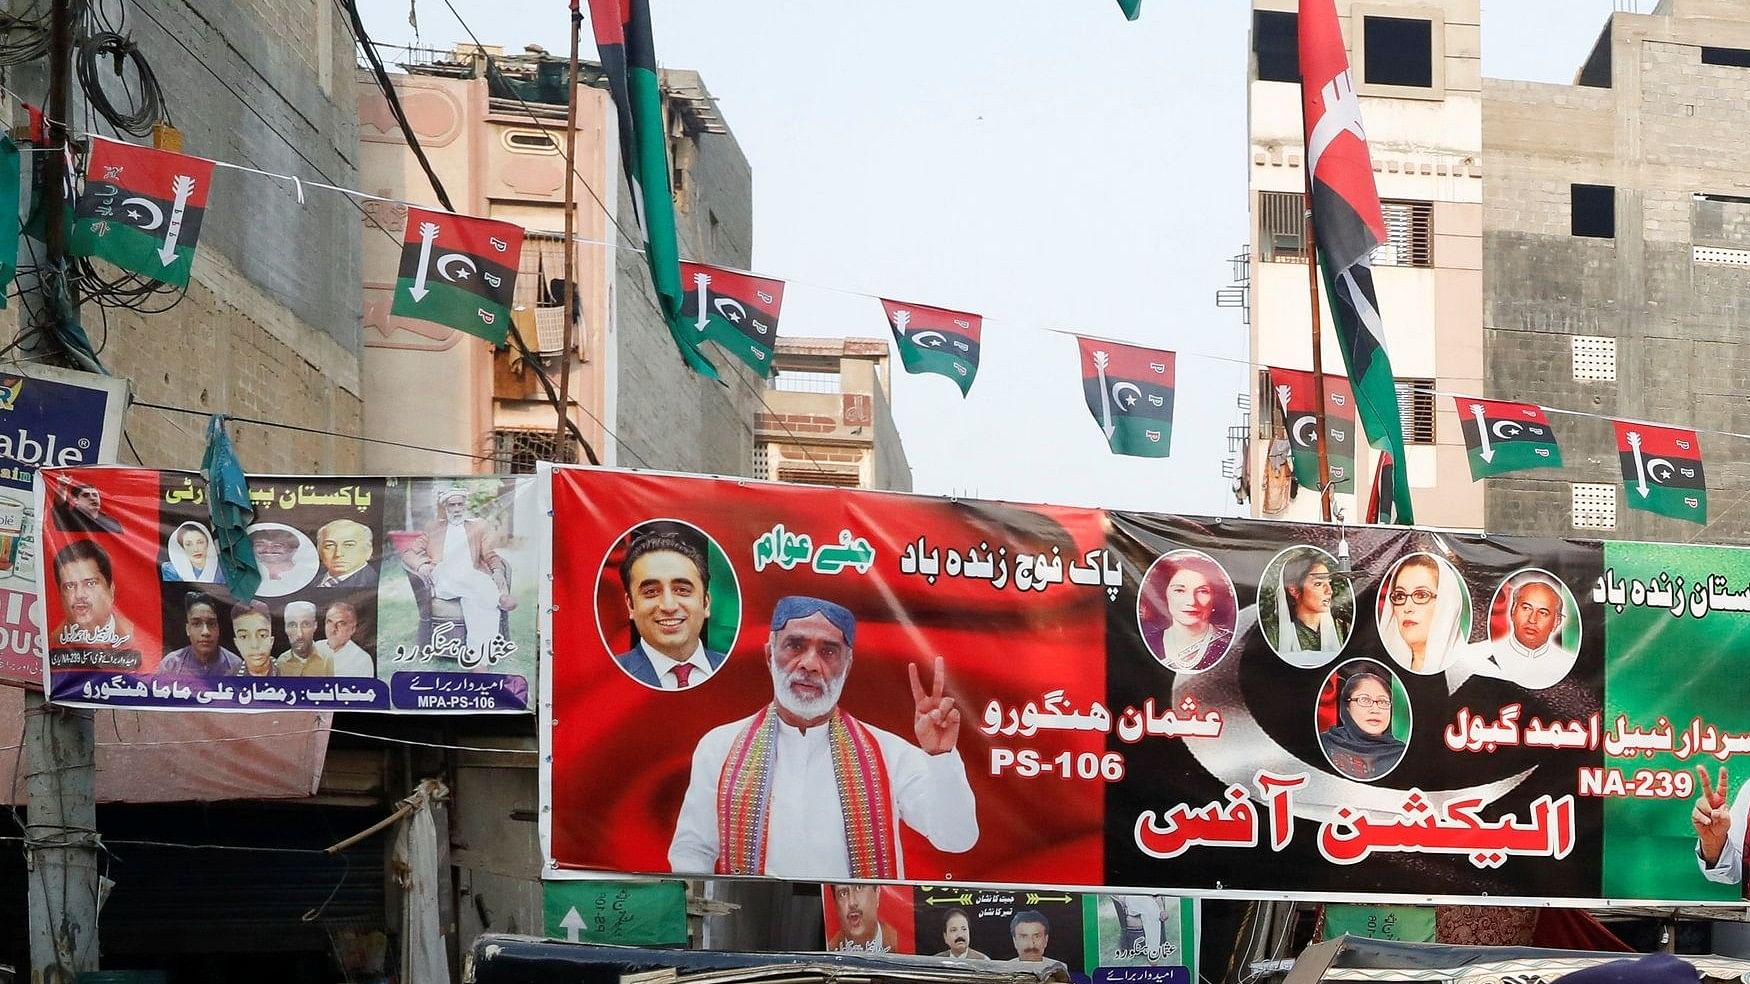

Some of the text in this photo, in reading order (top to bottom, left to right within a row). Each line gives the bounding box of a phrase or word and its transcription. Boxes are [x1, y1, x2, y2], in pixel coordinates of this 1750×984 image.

[279, 483, 371, 512] پاکستان
[753, 523, 813, 575] عوام
[899, 536, 1123, 601] پاک فوج زندہ باد
[1593, 567, 1627, 611] باد
[1626, 576, 1688, 618] زندہ
[458, 633, 519, 668] عثمان
[152, 679, 193, 700] ماما
[196, 682, 235, 704] علی
[238, 681, 297, 705] رمضان
[410, 675, 504, 695] امیدوار برائے
[417, 695, 496, 709] MPA-PS-106
[1116, 696, 1225, 742] عثمان
[1444, 703, 1521, 753] گبول
[1524, 714, 1600, 753] احمد
[1603, 711, 1681, 758] نبیل
[989, 749, 1125, 783] PS-106
[1578, 767, 1694, 799] NA-239
[1134, 771, 1576, 870] الیکشن آفس
[1146, 941, 1176, 961] عثمان
[1135, 969, 1174, 983] امیدوار
